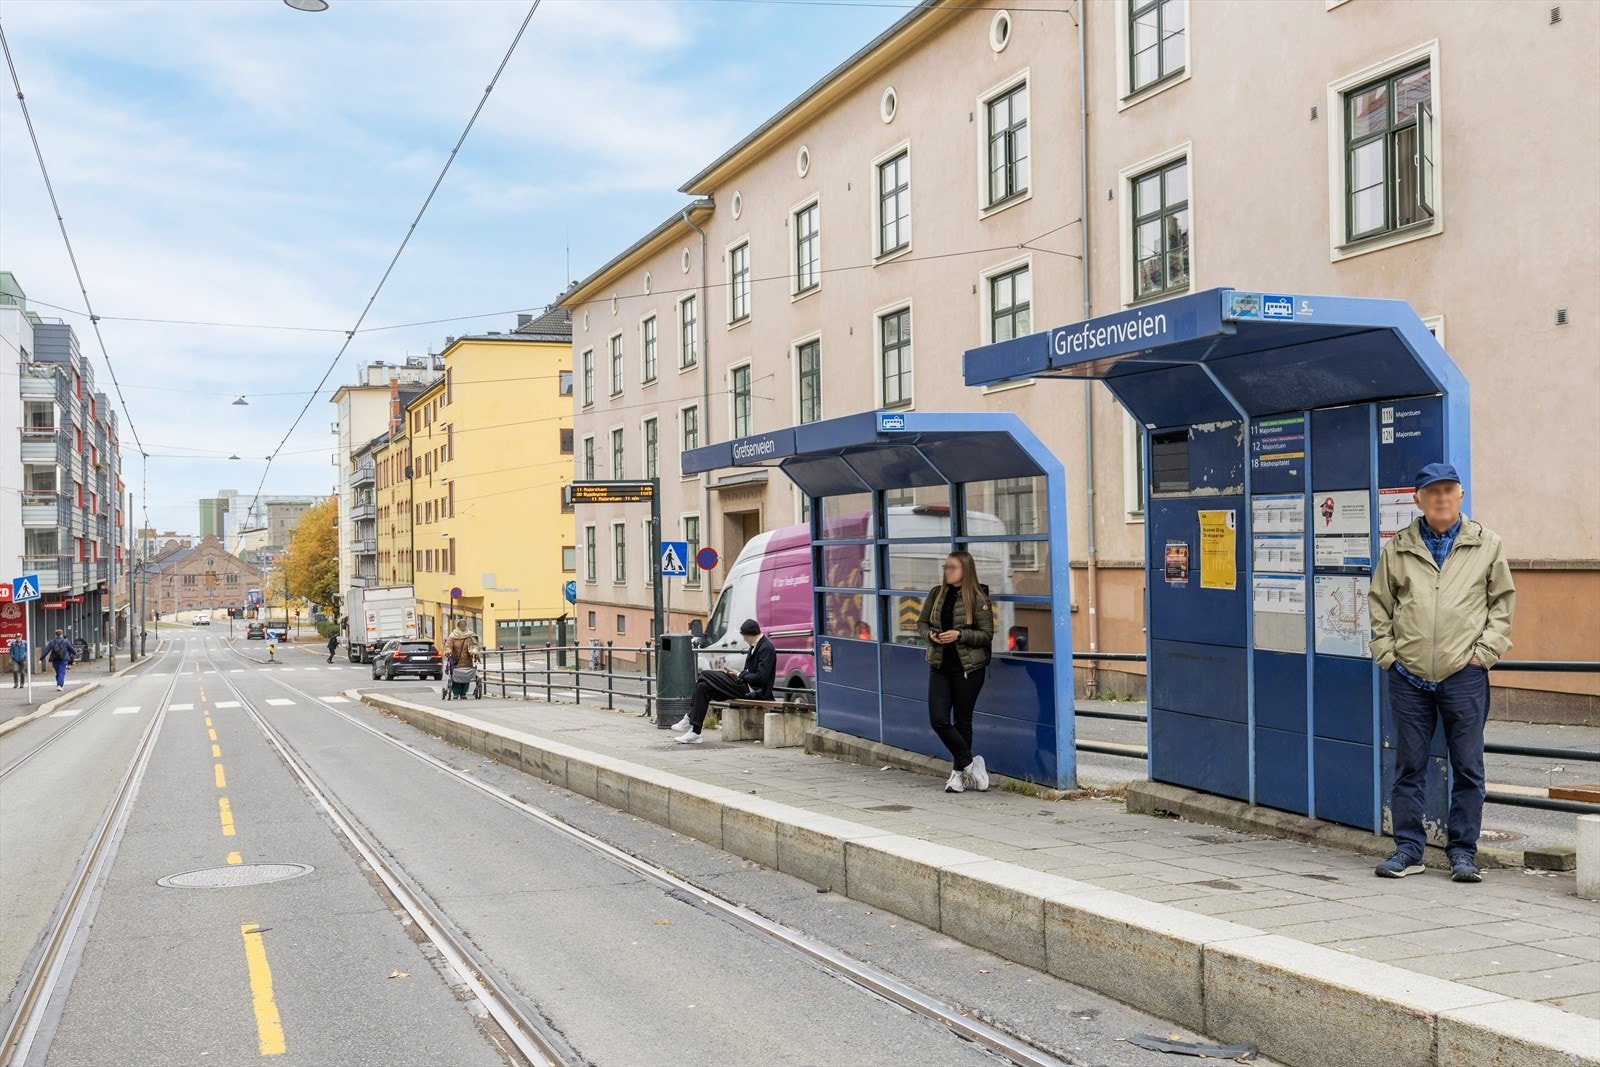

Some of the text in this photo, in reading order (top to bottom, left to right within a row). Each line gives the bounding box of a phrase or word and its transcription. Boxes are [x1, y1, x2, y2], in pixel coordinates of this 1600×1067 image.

[1055, 312, 1167, 355] Grefsenveien
[1382, 410, 1421, 421] 11N Majorstuen
[1251, 426, 1283, 435] 11 Majorstuen
[1382, 430, 1422, 440] 12N Majorstuen
[733, 436, 775, 459] Grefsenveien
[1252, 442, 1287, 451] 12 Majorstuen
[1251, 459, 1290, 468] 18 Rikshospitalet
